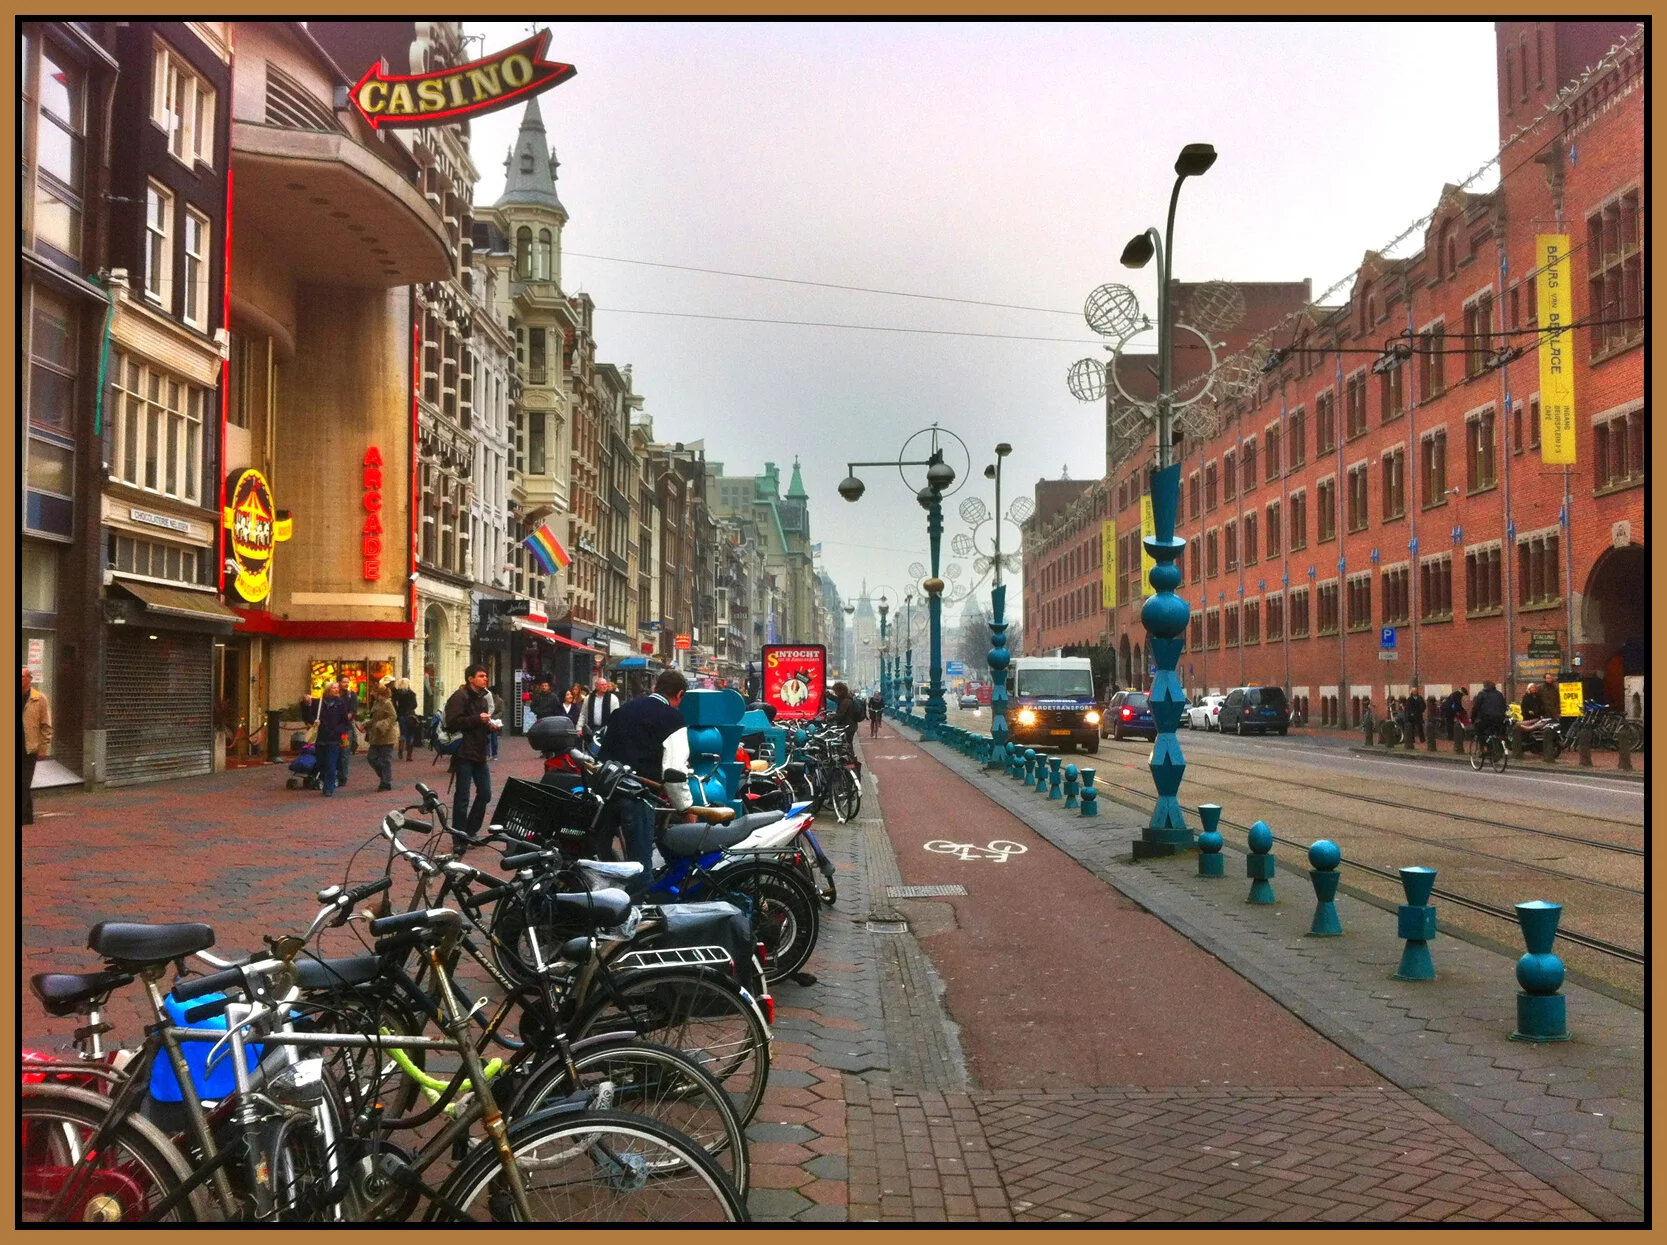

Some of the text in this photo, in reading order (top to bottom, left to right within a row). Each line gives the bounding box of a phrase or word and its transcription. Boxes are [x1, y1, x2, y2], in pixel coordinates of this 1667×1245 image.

[358, 54, 534, 114] CASINO
[1547, 245, 1558, 288] BEURS
[363, 445, 383, 581] ARCADE
[1384, 629, 1392, 641] P
[1563, 692, 1578, 700] OPEN
